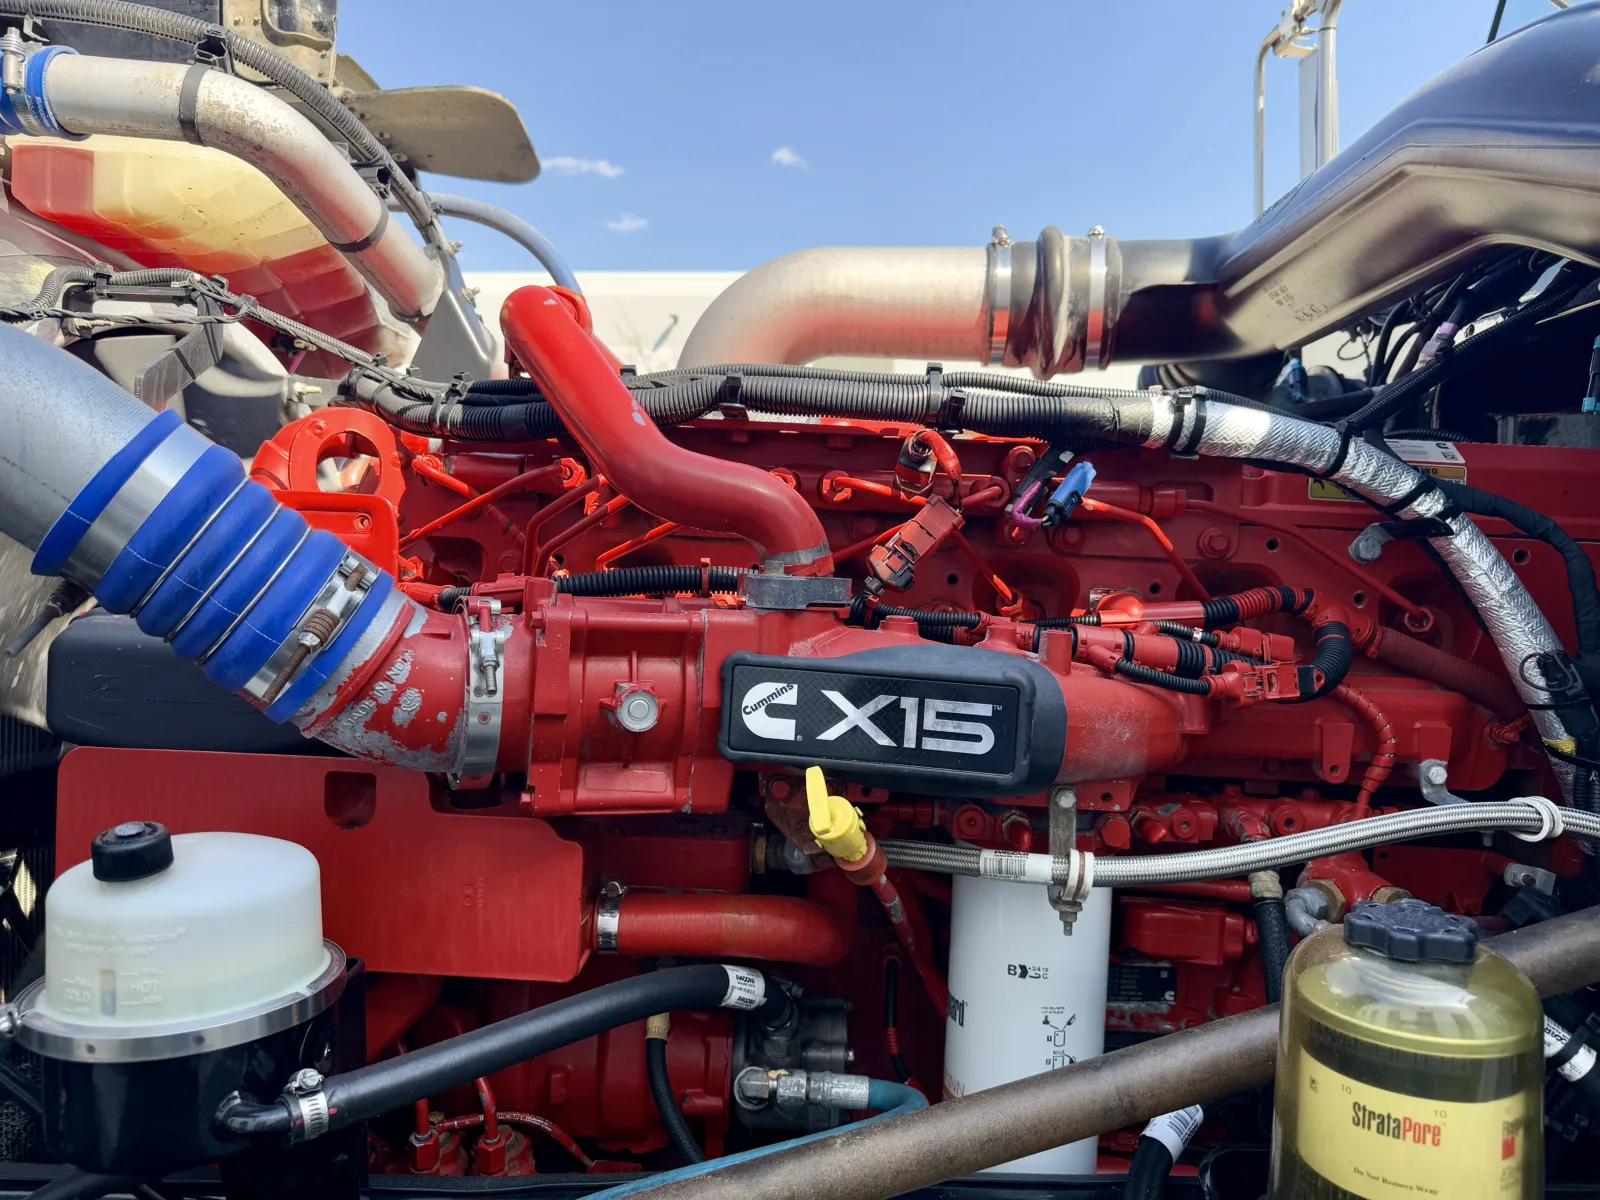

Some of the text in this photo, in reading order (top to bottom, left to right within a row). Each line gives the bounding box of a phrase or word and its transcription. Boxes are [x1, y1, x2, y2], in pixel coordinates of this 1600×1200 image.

[343, 698, 376, 729] MADE
[374, 681, 388, 698] IN
[742, 683, 795, 716] Cummins
[815, 690, 995, 755] X15
[129, 980, 162, 992] HOT
[1007, 964, 1018, 976] B
[1352, 1101, 1441, 1147] StrataPore
[1353, 1166, 1439, 1196] Do Not Remove Wrap
